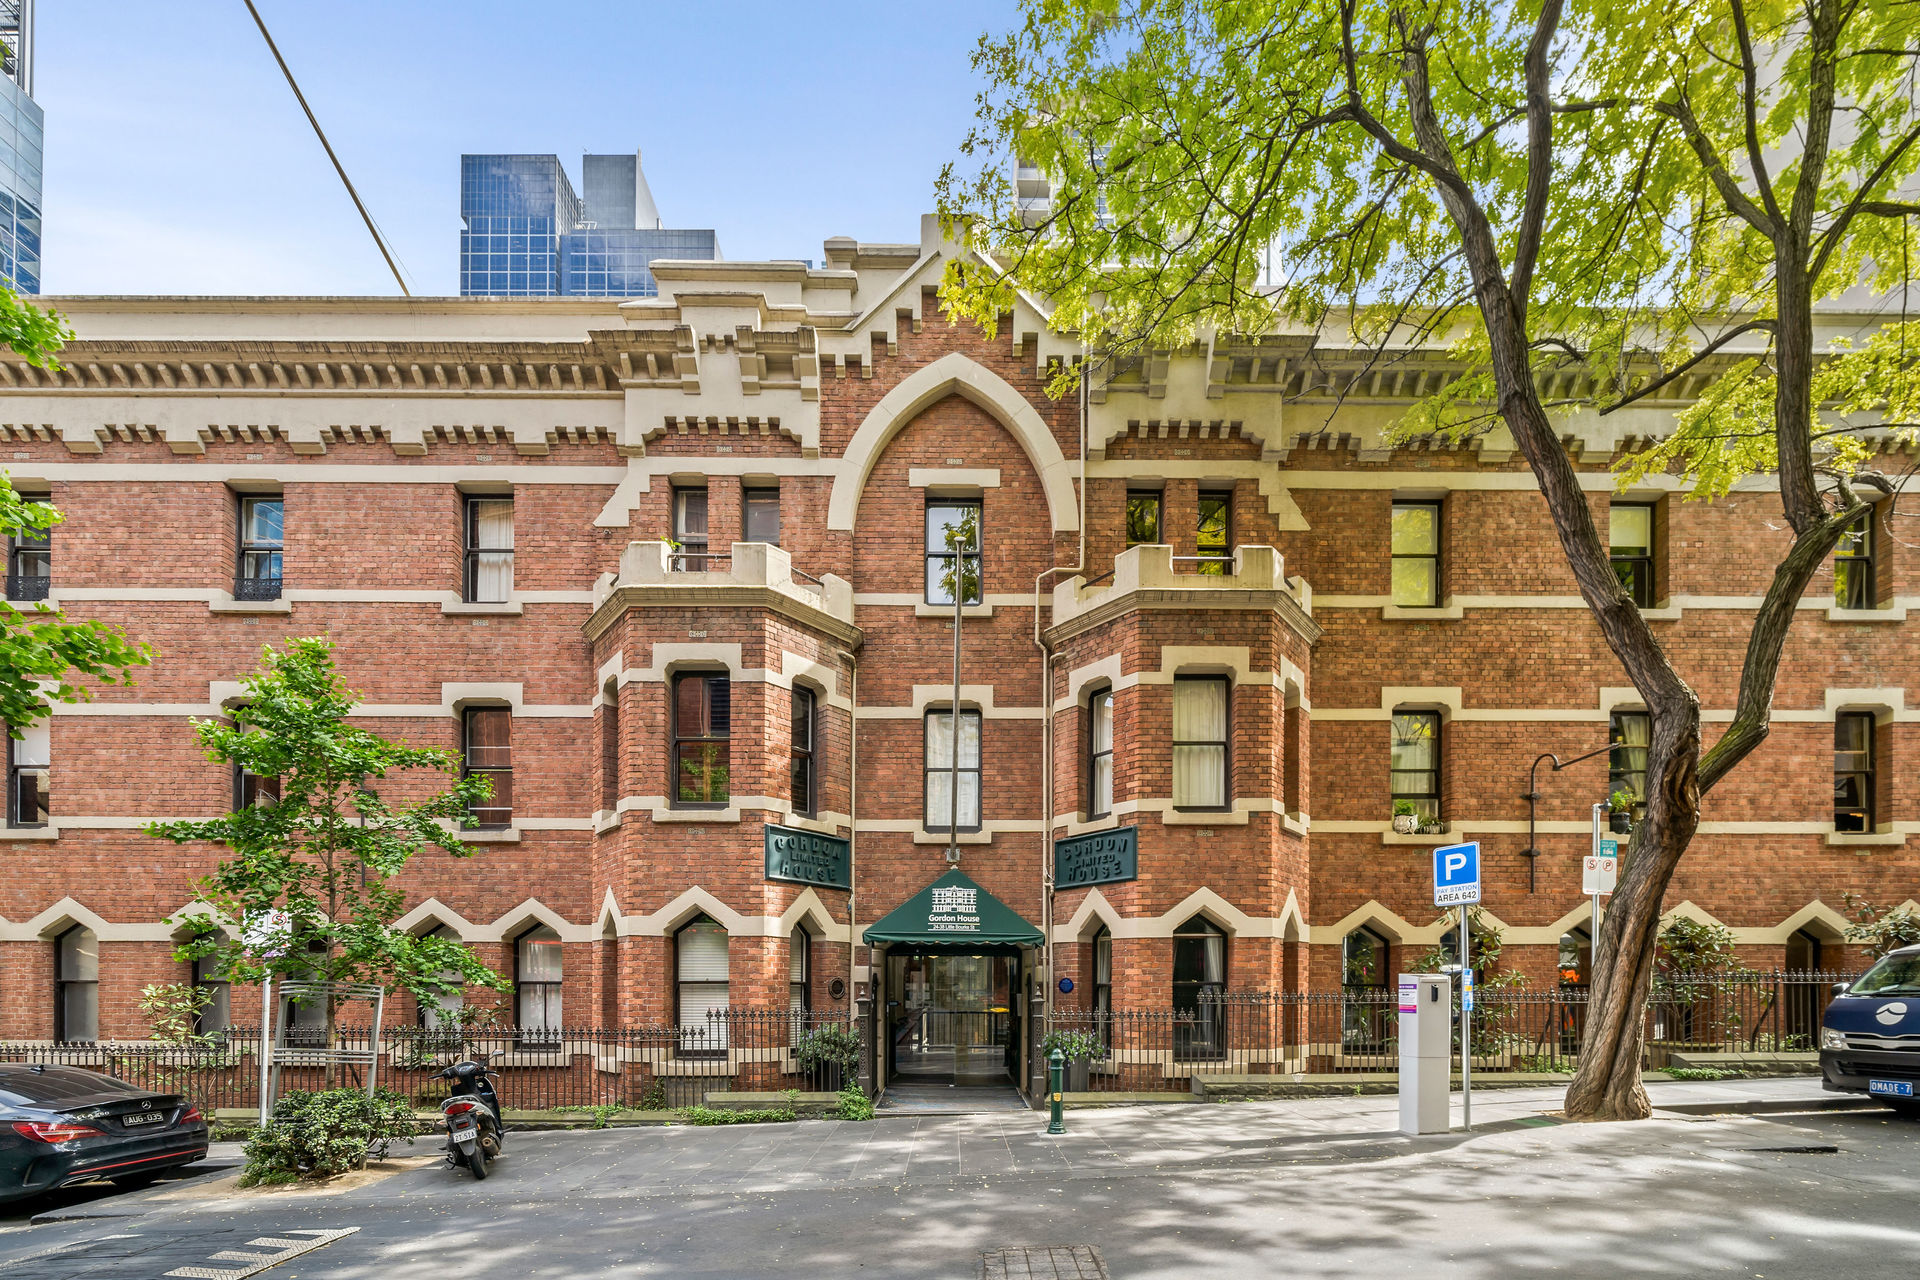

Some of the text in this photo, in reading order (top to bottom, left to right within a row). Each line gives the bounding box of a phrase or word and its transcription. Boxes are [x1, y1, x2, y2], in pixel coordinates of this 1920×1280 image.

[775, 836, 840, 860] GORDON
[1064, 838, 1128, 861] GORDON
[791, 850, 830, 866] LIMITED
[1075, 853, 1116, 869] LIMITED
[1445, 853, 1467, 881] P
[781, 859, 838, 881] HOUSE
[1068, 860, 1122, 881] HOUSE
[1437, 890, 1477, 903] AREA 642
[1450, 884, 1477, 893] STATION
[928, 914, 956, 922] Gordon
